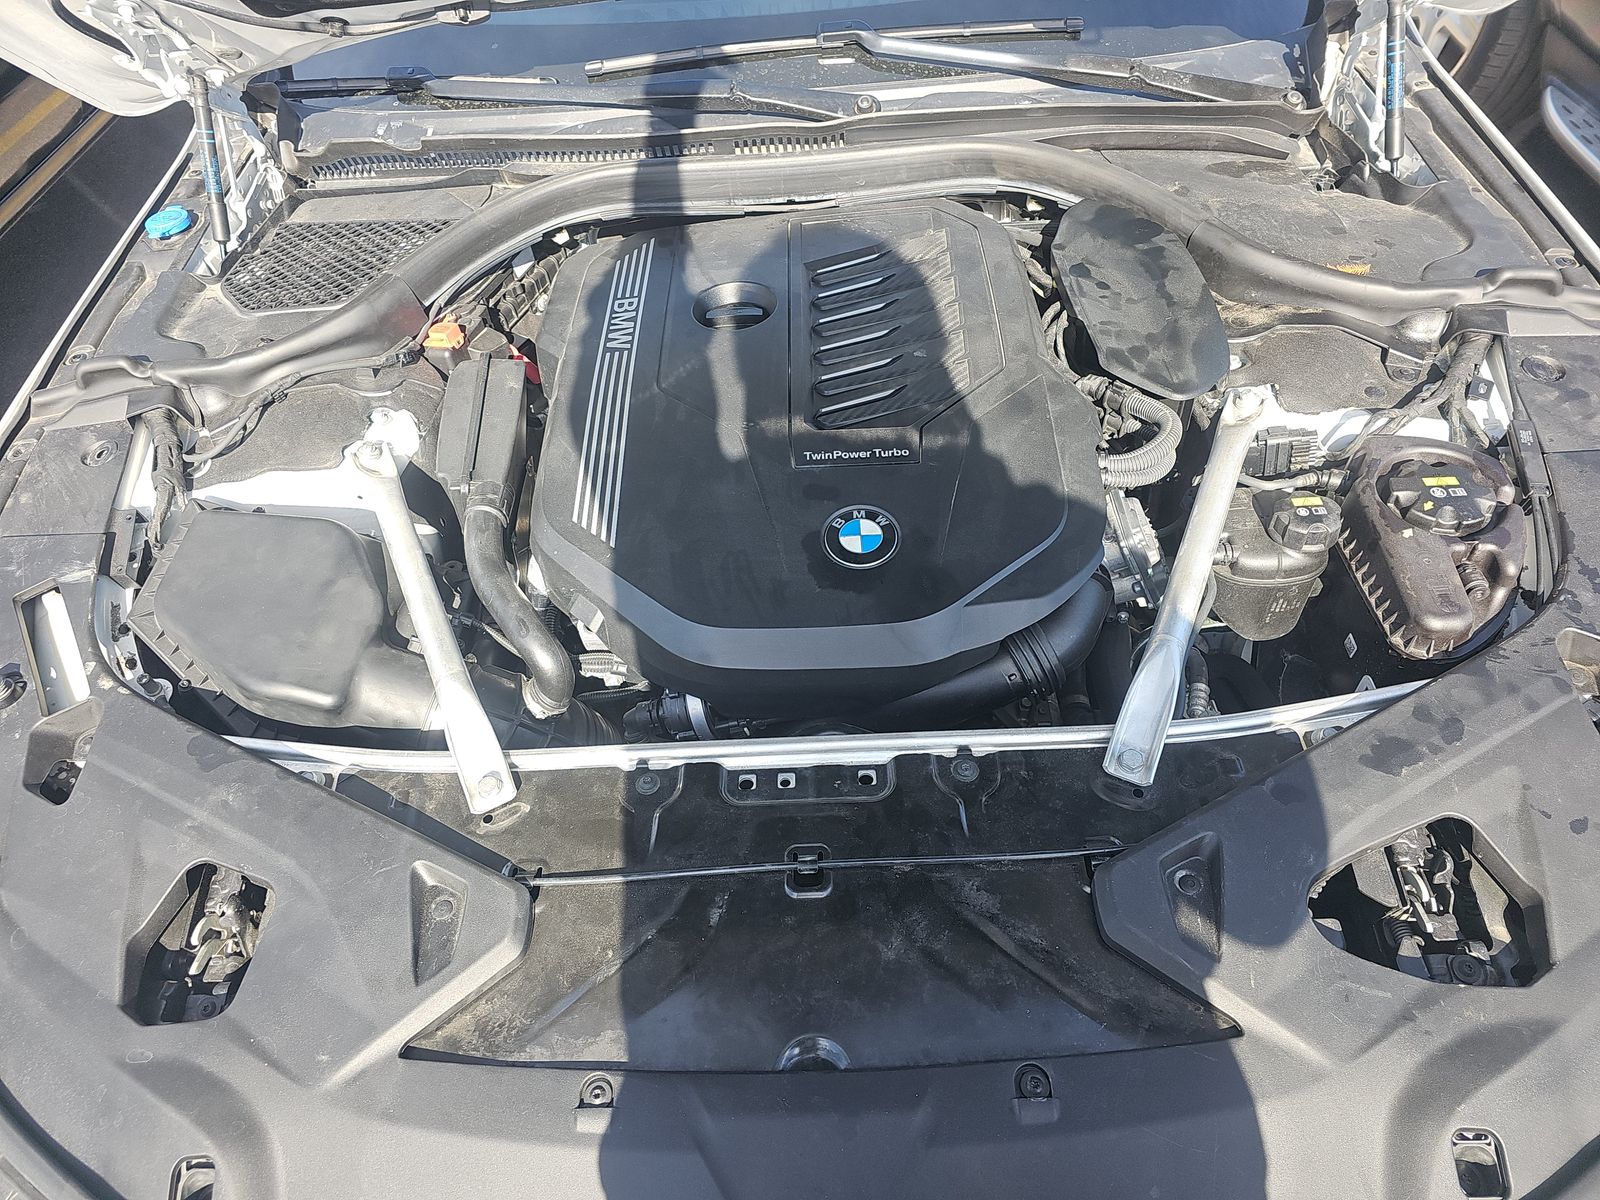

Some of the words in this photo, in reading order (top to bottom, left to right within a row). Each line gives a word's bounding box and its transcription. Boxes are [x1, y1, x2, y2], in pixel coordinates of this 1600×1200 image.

[606, 297, 639, 349] BMW
[803, 450, 872, 460] TwinPower
[873, 448, 910, 458] Turbo
[832, 510, 890, 529] BMW
